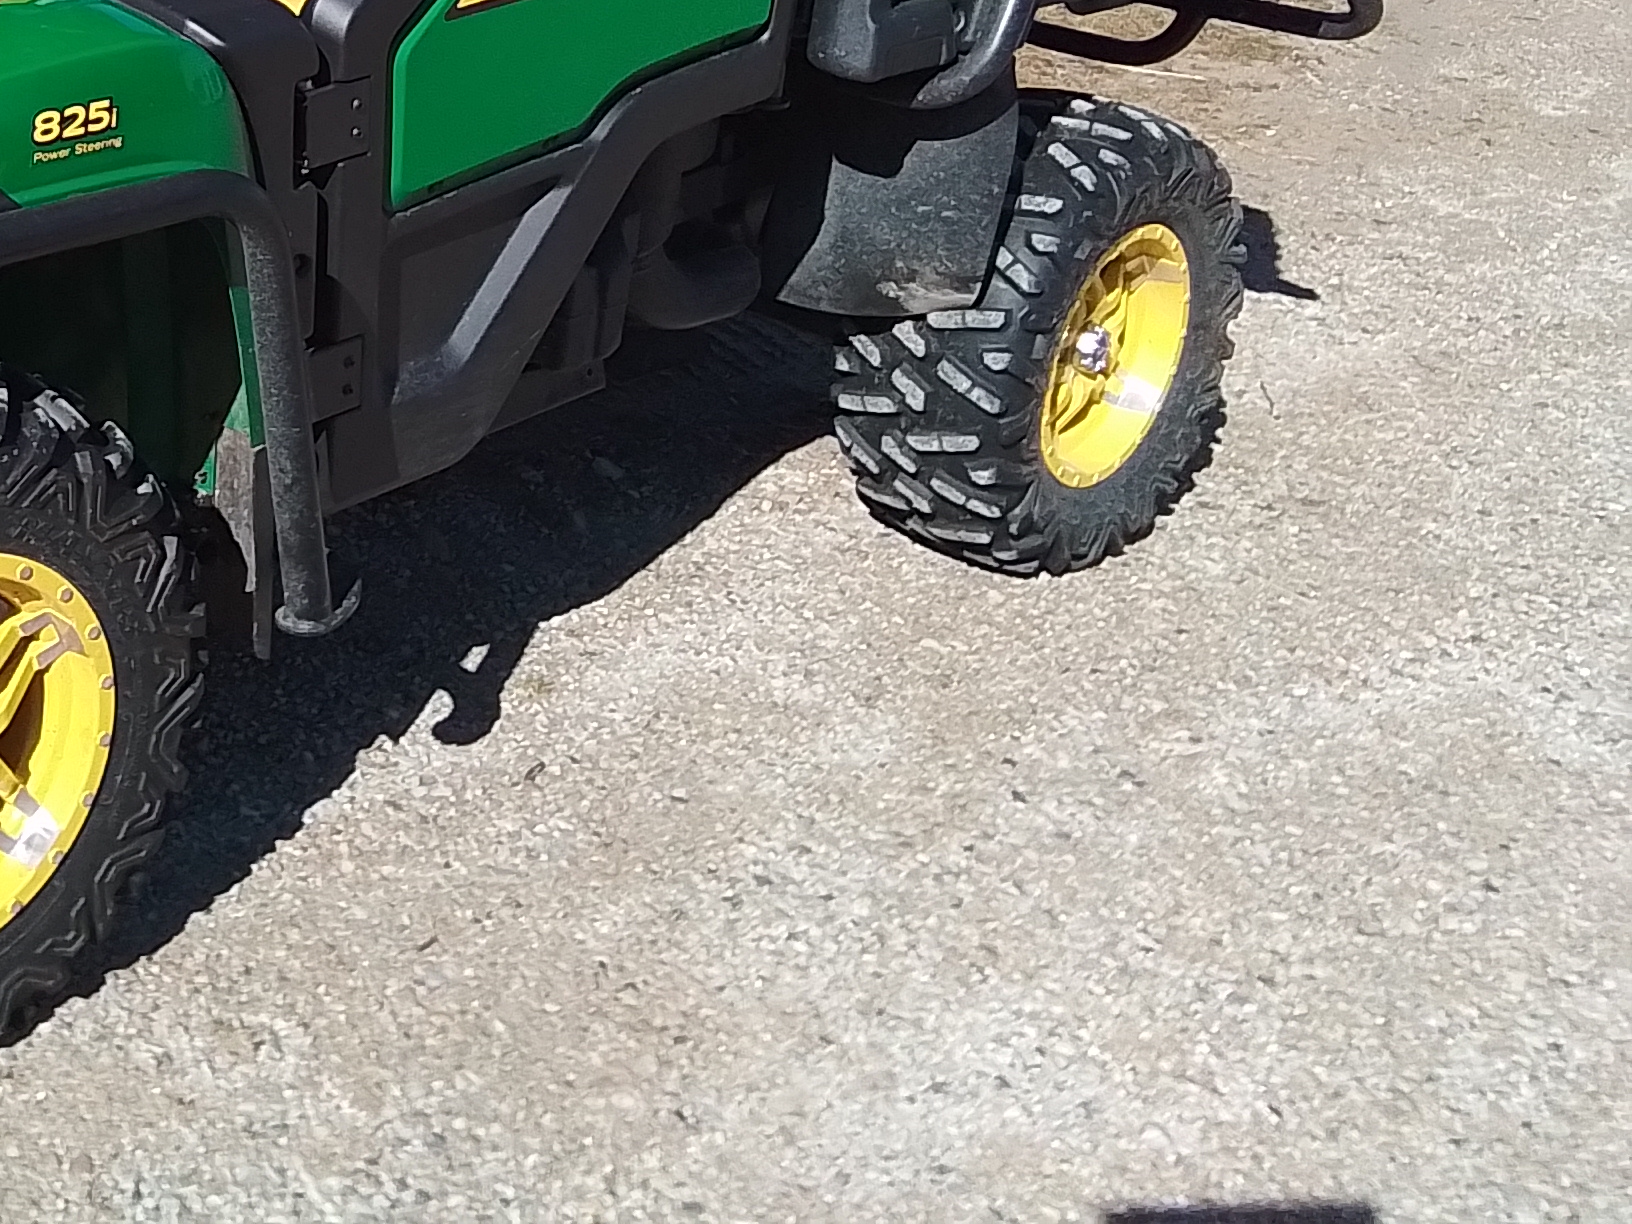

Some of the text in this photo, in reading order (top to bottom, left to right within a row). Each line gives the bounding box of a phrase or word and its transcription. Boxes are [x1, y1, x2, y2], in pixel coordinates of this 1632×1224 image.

[33, 99, 118, 143] 825i
[33, 136, 123, 164] Power Steering
